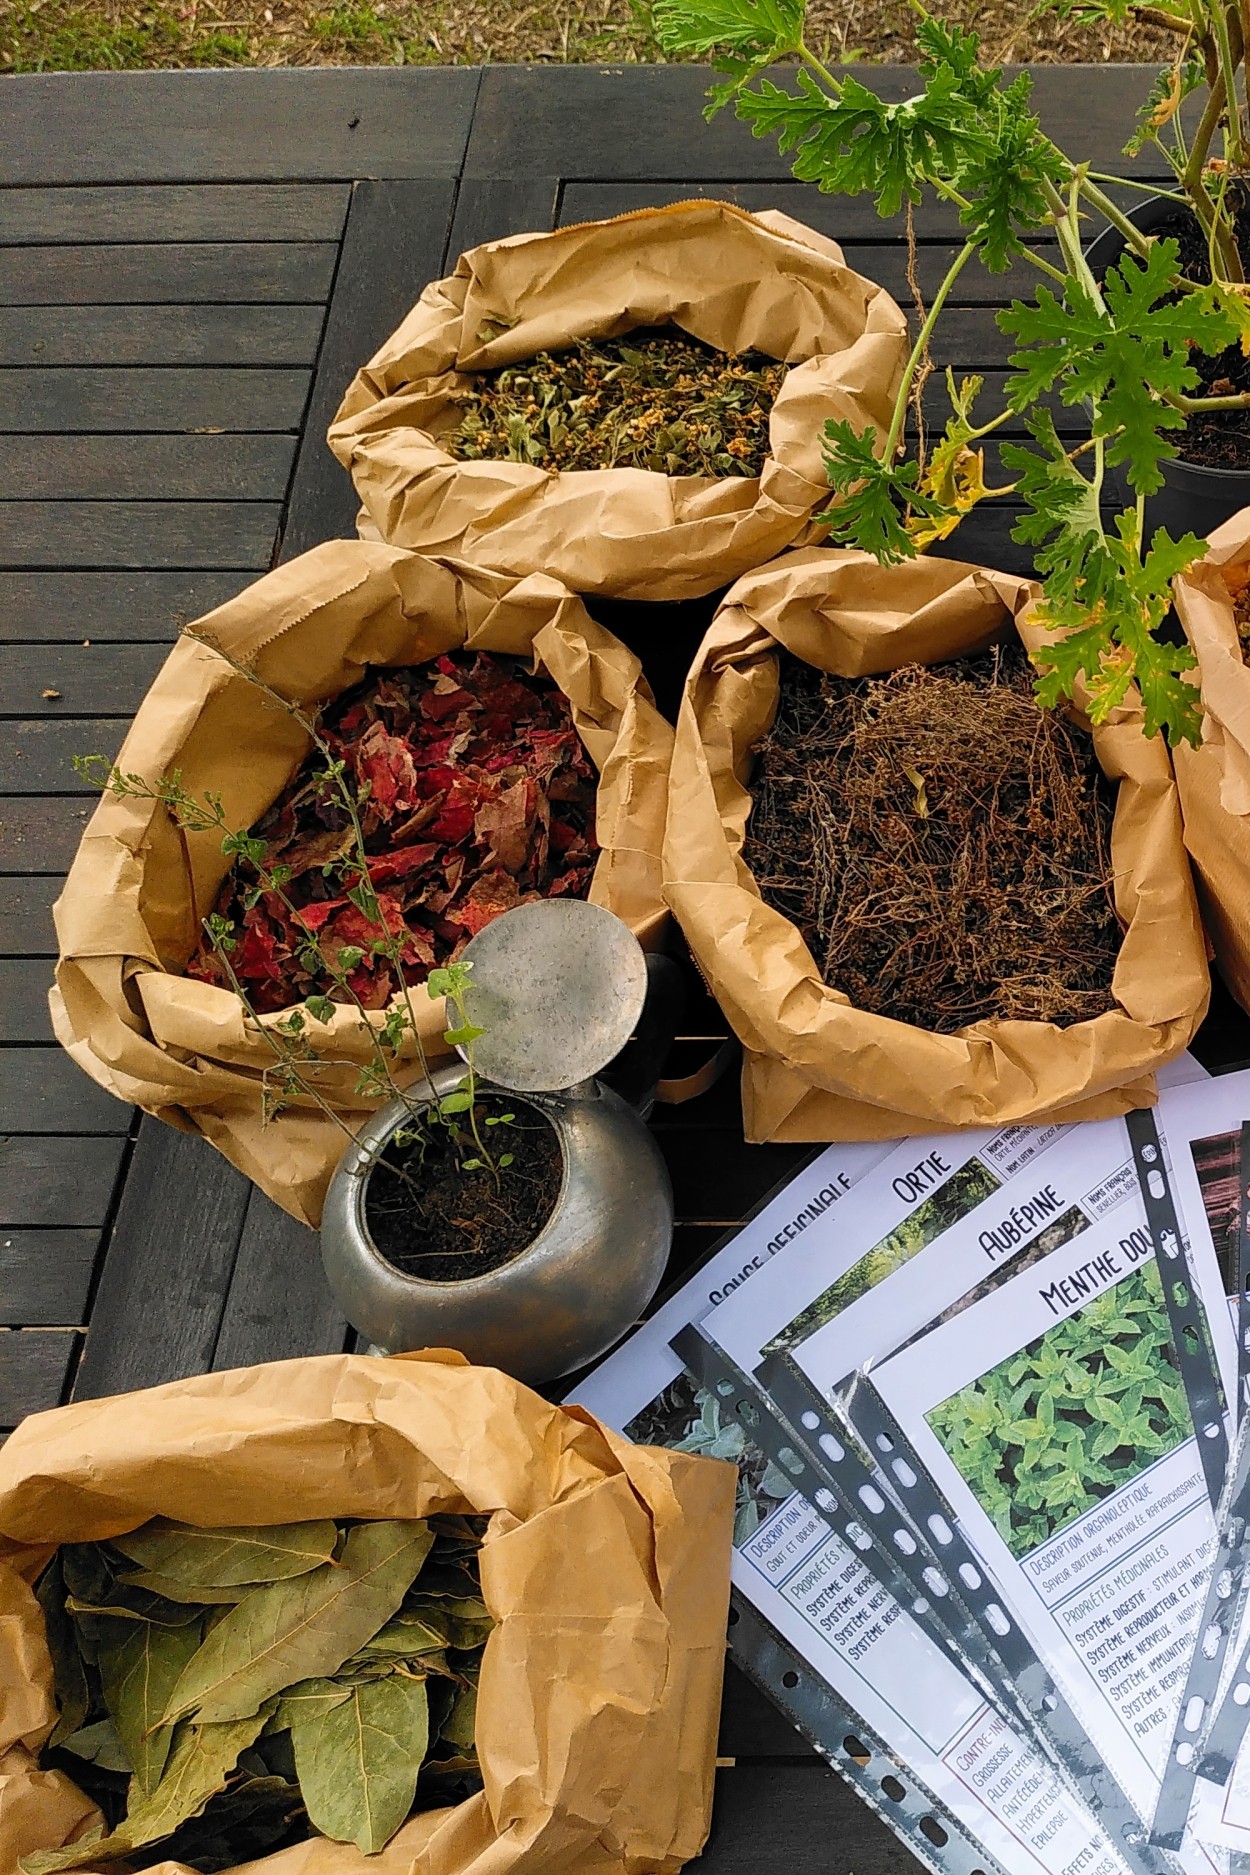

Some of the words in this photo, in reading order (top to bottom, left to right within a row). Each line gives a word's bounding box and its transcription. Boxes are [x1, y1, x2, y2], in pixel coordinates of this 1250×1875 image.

[893, 1151, 951, 1204] ORTIE
[979, 1184, 1066, 1261] AUBÉPINE
[1038, 1250, 1122, 1315] MENTHE
[750, 1506, 801, 1558] DESCRIPTION
[765, 1549, 787, 1572] GOUT
[784, 1539, 797, 1554] ET
[794, 1520, 818, 1543] ODEUR
[790, 1549, 840, 1599] PROPRIÉTÉS
[1062, 1583, 1115, 1626] PROPRIÉTÉS
[1113, 1543, 1169, 1590] MÉDICINALES
[1074, 1615, 1112, 1647] SYSTÈME
[1113, 1593, 1148, 1619] DIGESTIF
[1152, 1554, 1197, 1589] STIMULANT
[833, 1607, 871, 1645] SYSTÈME
[1086, 1631, 1126, 1665] SYSTÈME
[1123, 1591, 1179, 1638] REPRODUCTEUR
[1177, 1581, 1190, 1598] ET
[1133, 1707, 1167, 1738] AUTRES
